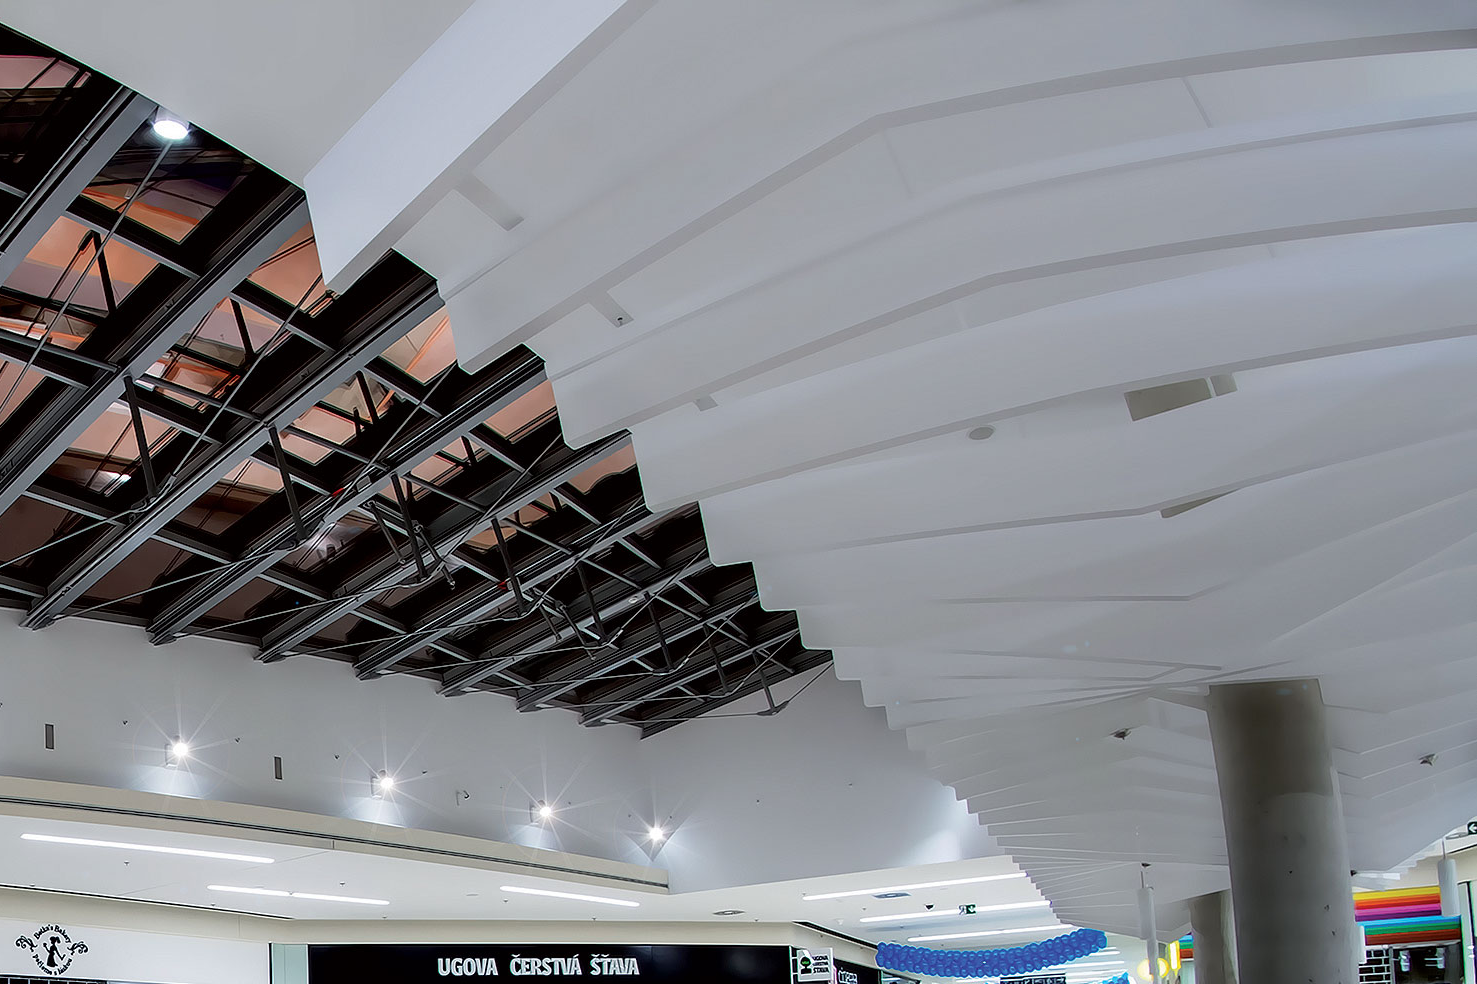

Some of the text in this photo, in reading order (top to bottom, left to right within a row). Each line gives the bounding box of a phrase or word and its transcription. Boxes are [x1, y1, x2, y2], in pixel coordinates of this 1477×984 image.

[437, 953, 641, 977] UGOVA ČERSTVÁ ŠŤAVA
